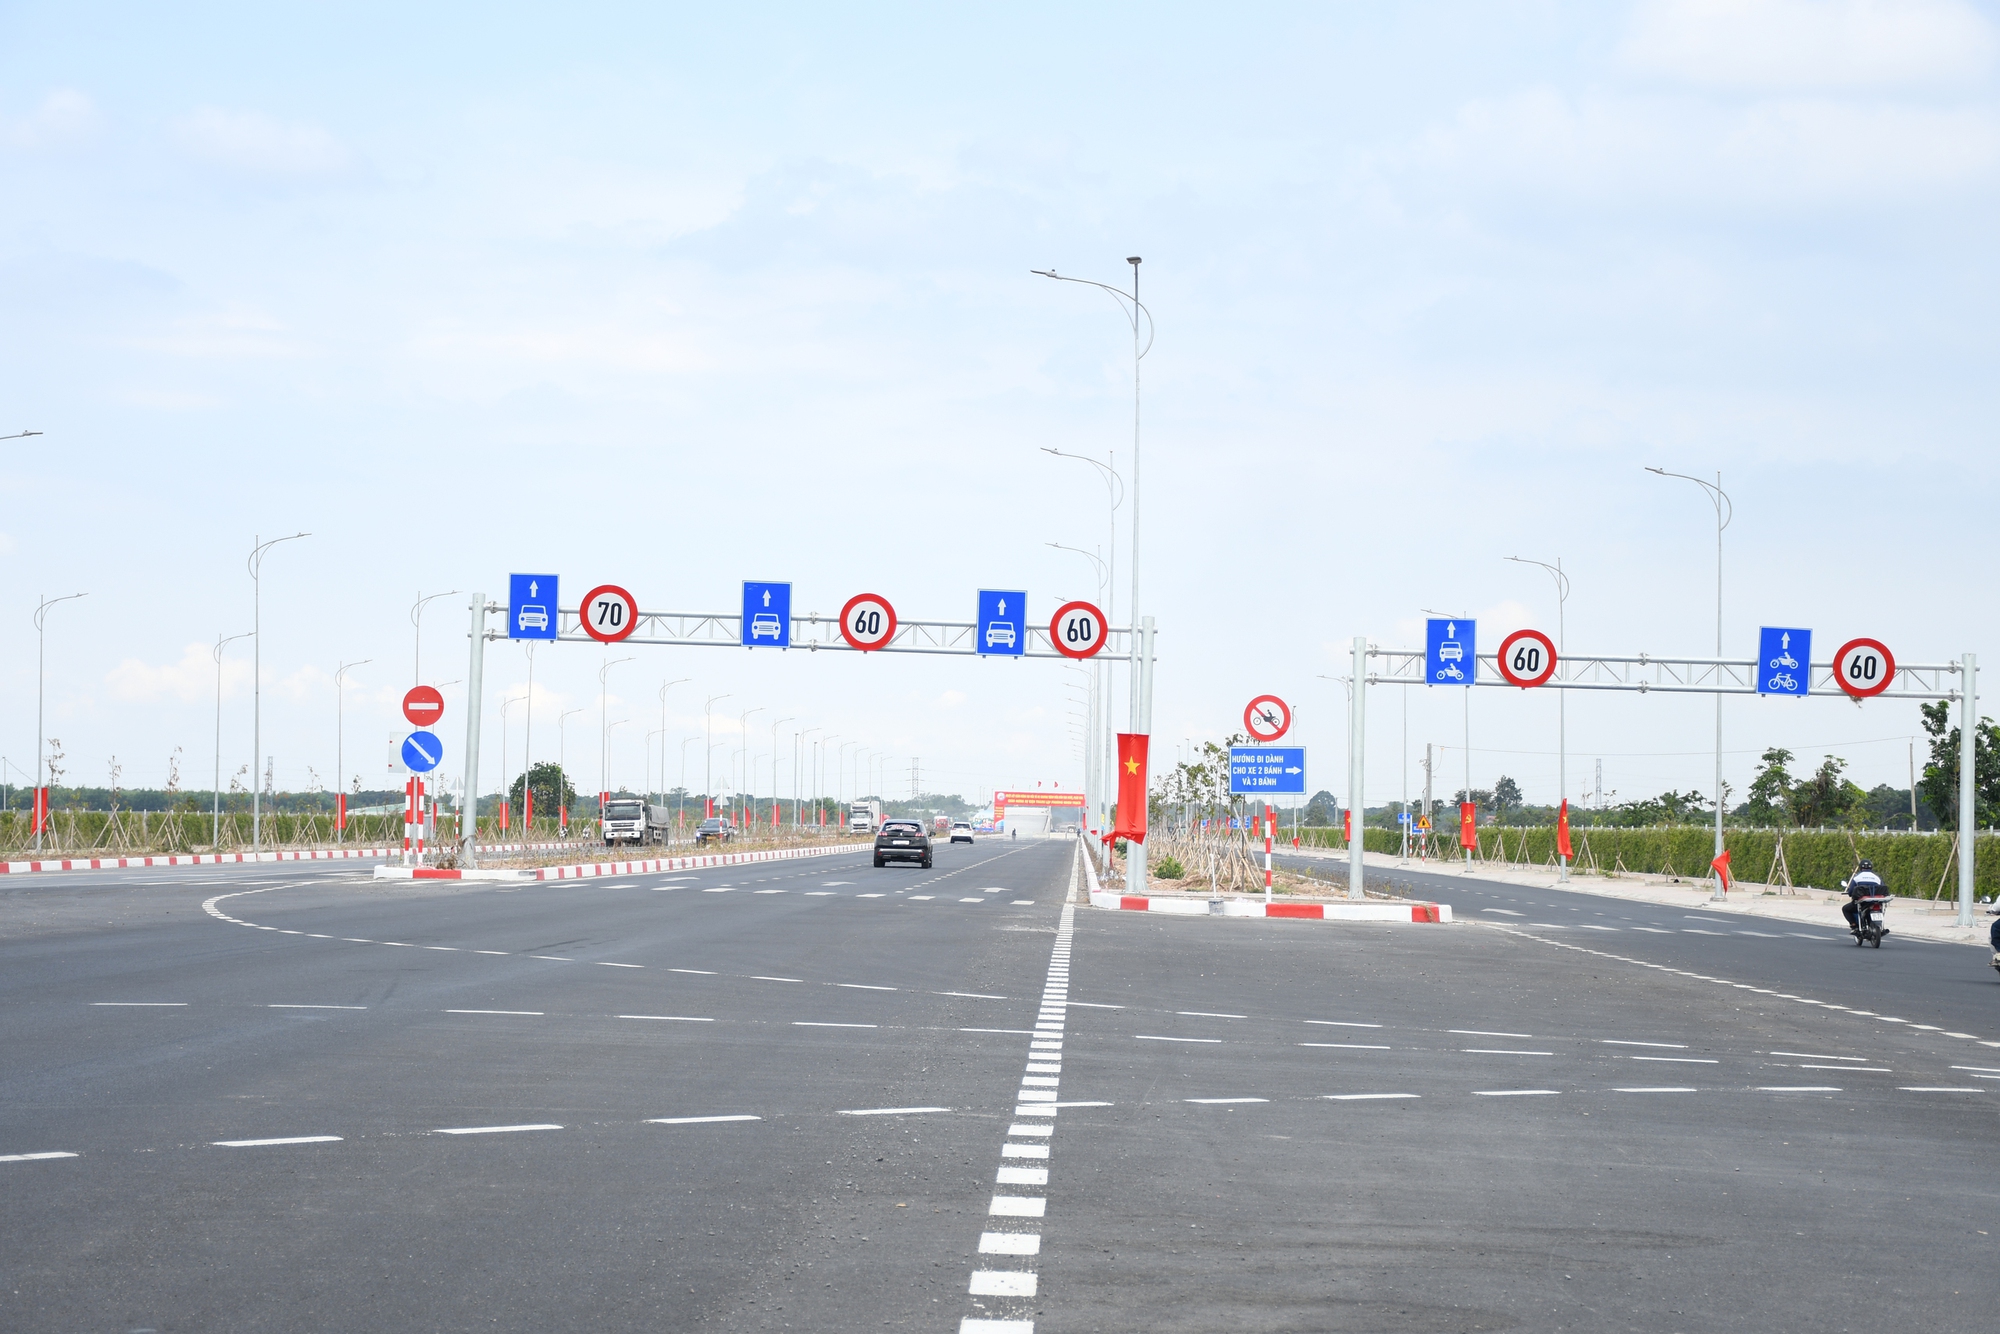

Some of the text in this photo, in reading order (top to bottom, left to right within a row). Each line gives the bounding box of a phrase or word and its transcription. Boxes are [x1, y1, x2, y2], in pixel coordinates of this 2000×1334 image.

[598, 602, 622, 626] 70
[856, 610, 880, 635] 60
[1067, 618, 1092, 642] 60
[1514, 647, 1540, 672] 60
[1850, 655, 1877, 680] 60
[1232, 753, 1284, 763] HƯỚNG ĐI DÀNH
[1232, 764, 1282, 774] CHO XE 2 BÁNH
[1242, 776, 1252, 786] VÀ
[1258, 776, 1276, 786] BÁNH
